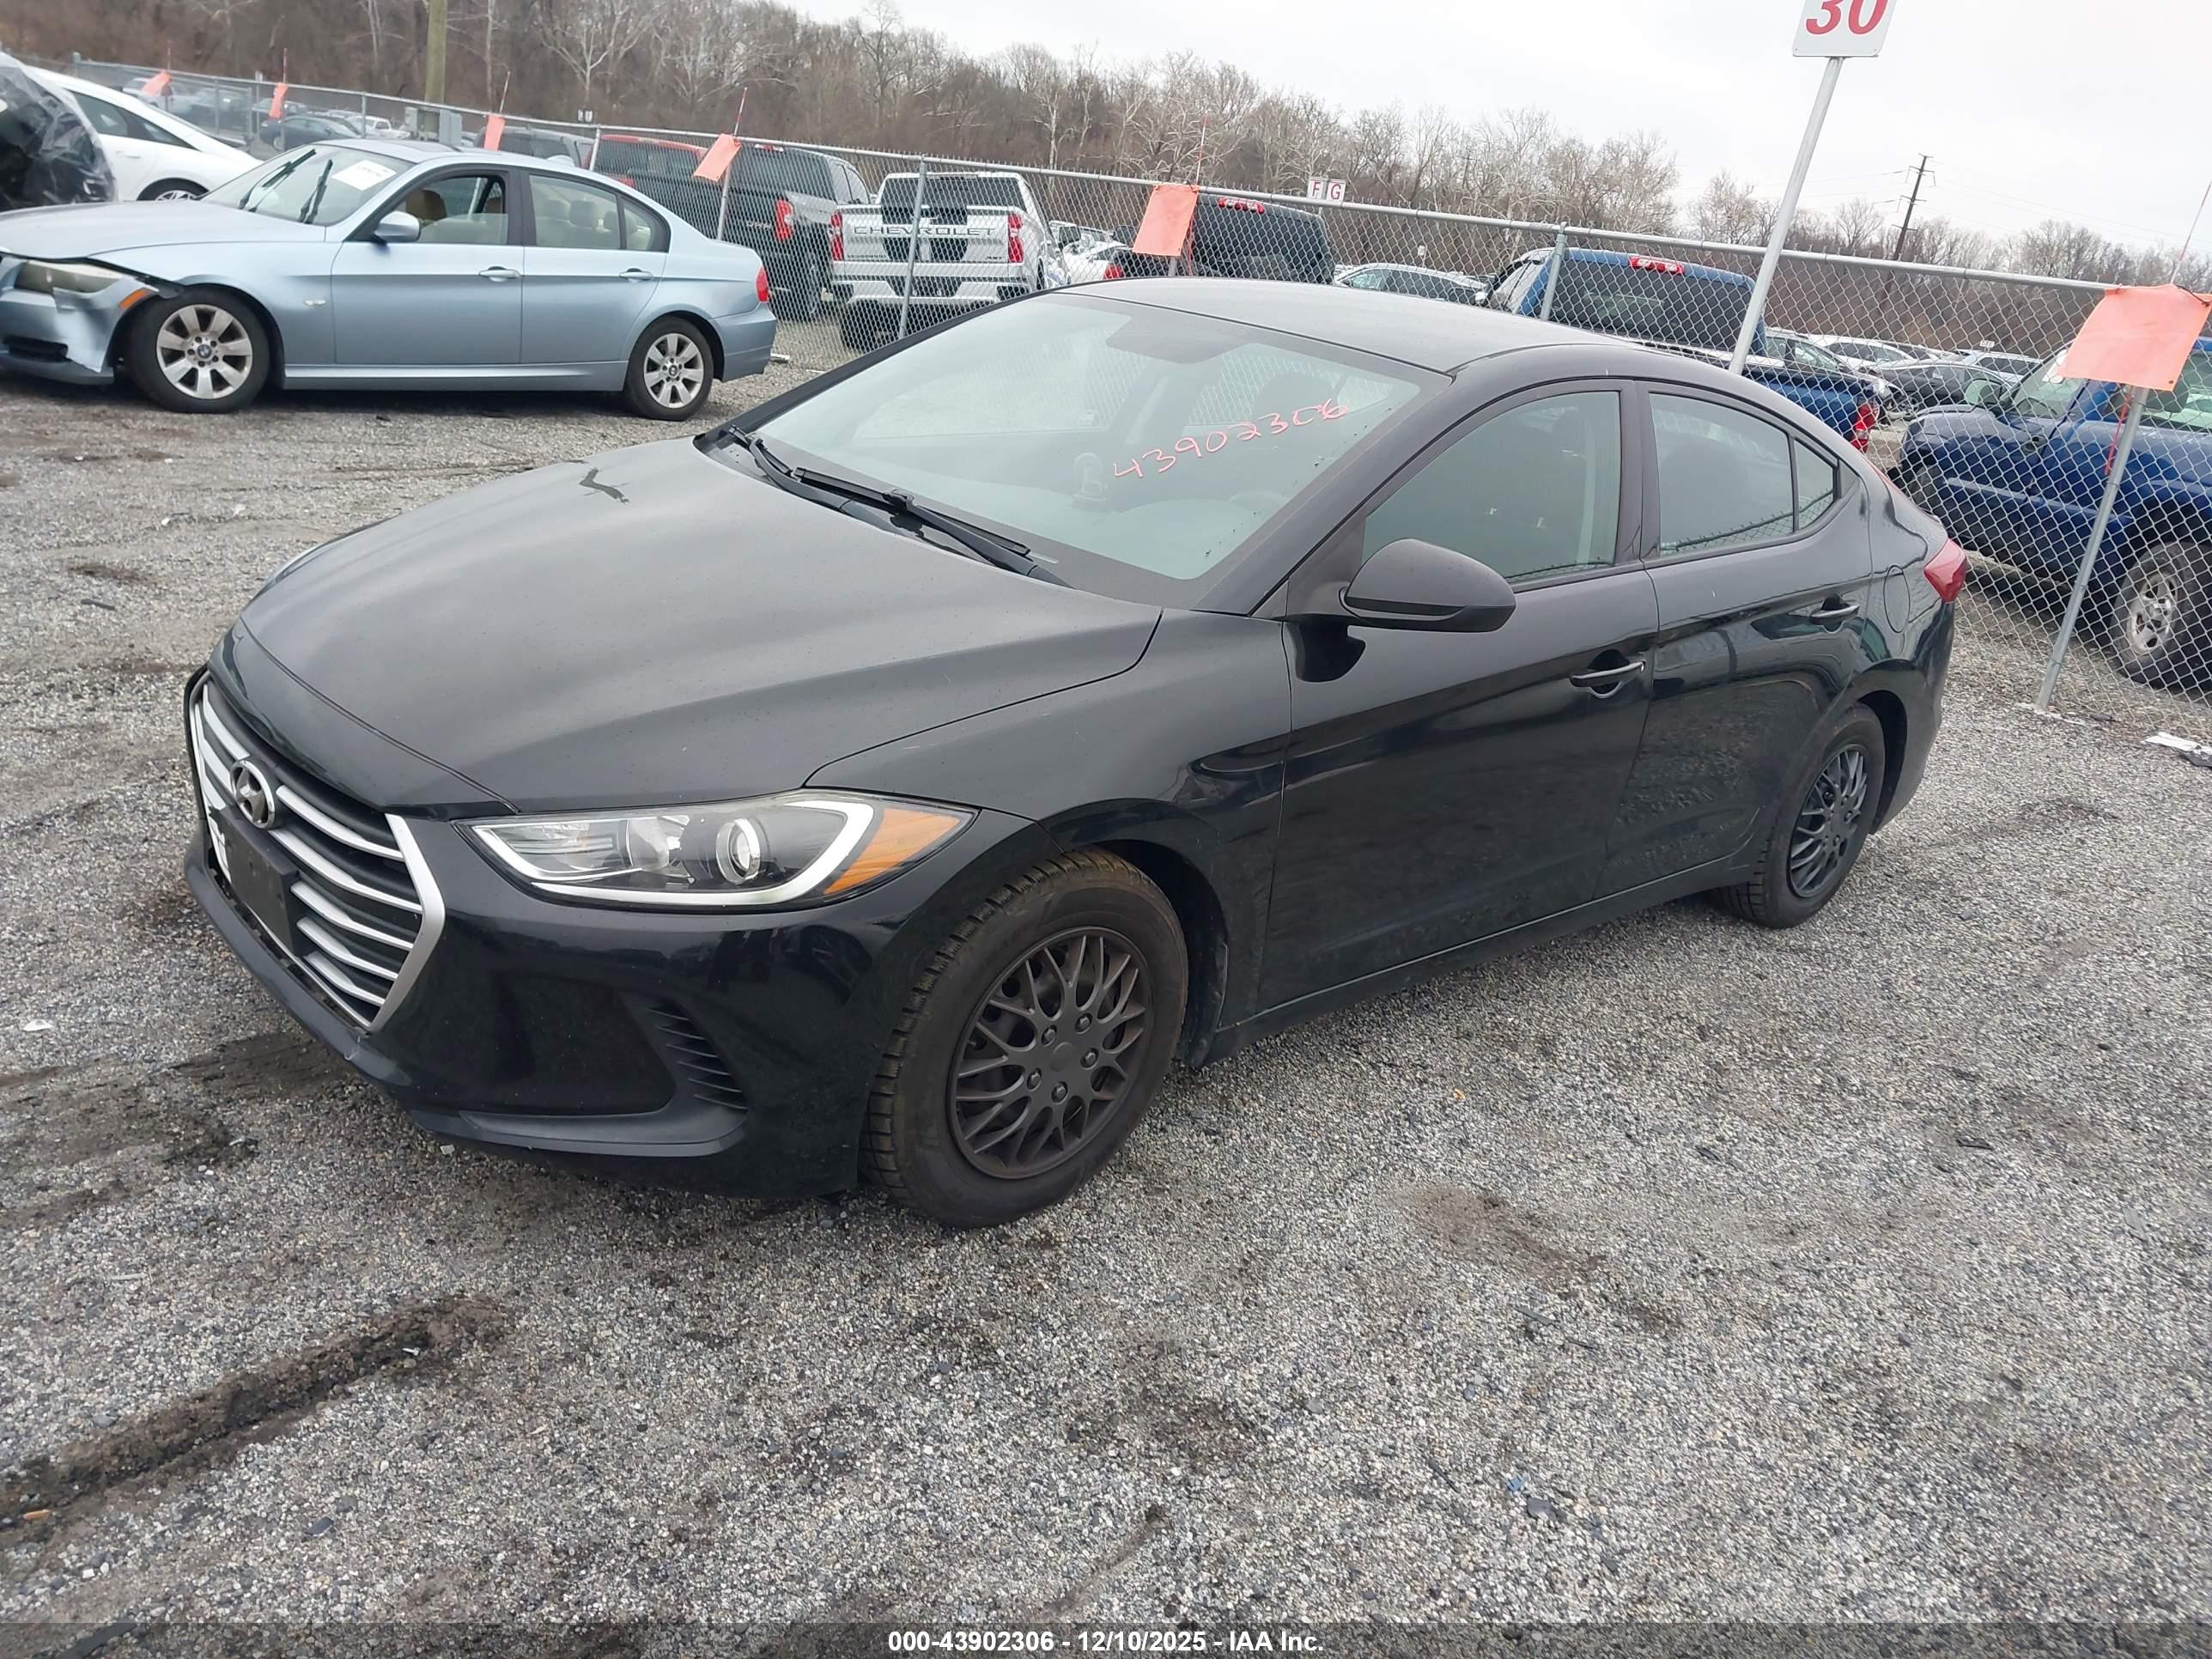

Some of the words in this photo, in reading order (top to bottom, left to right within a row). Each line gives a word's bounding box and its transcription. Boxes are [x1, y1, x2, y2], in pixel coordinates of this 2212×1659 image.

[1806, 0, 1888, 34] 30
[1312, 180, 1322, 198] F
[1330, 183, 1341, 200] G
[854, 226, 996, 236] CHEVROLET
